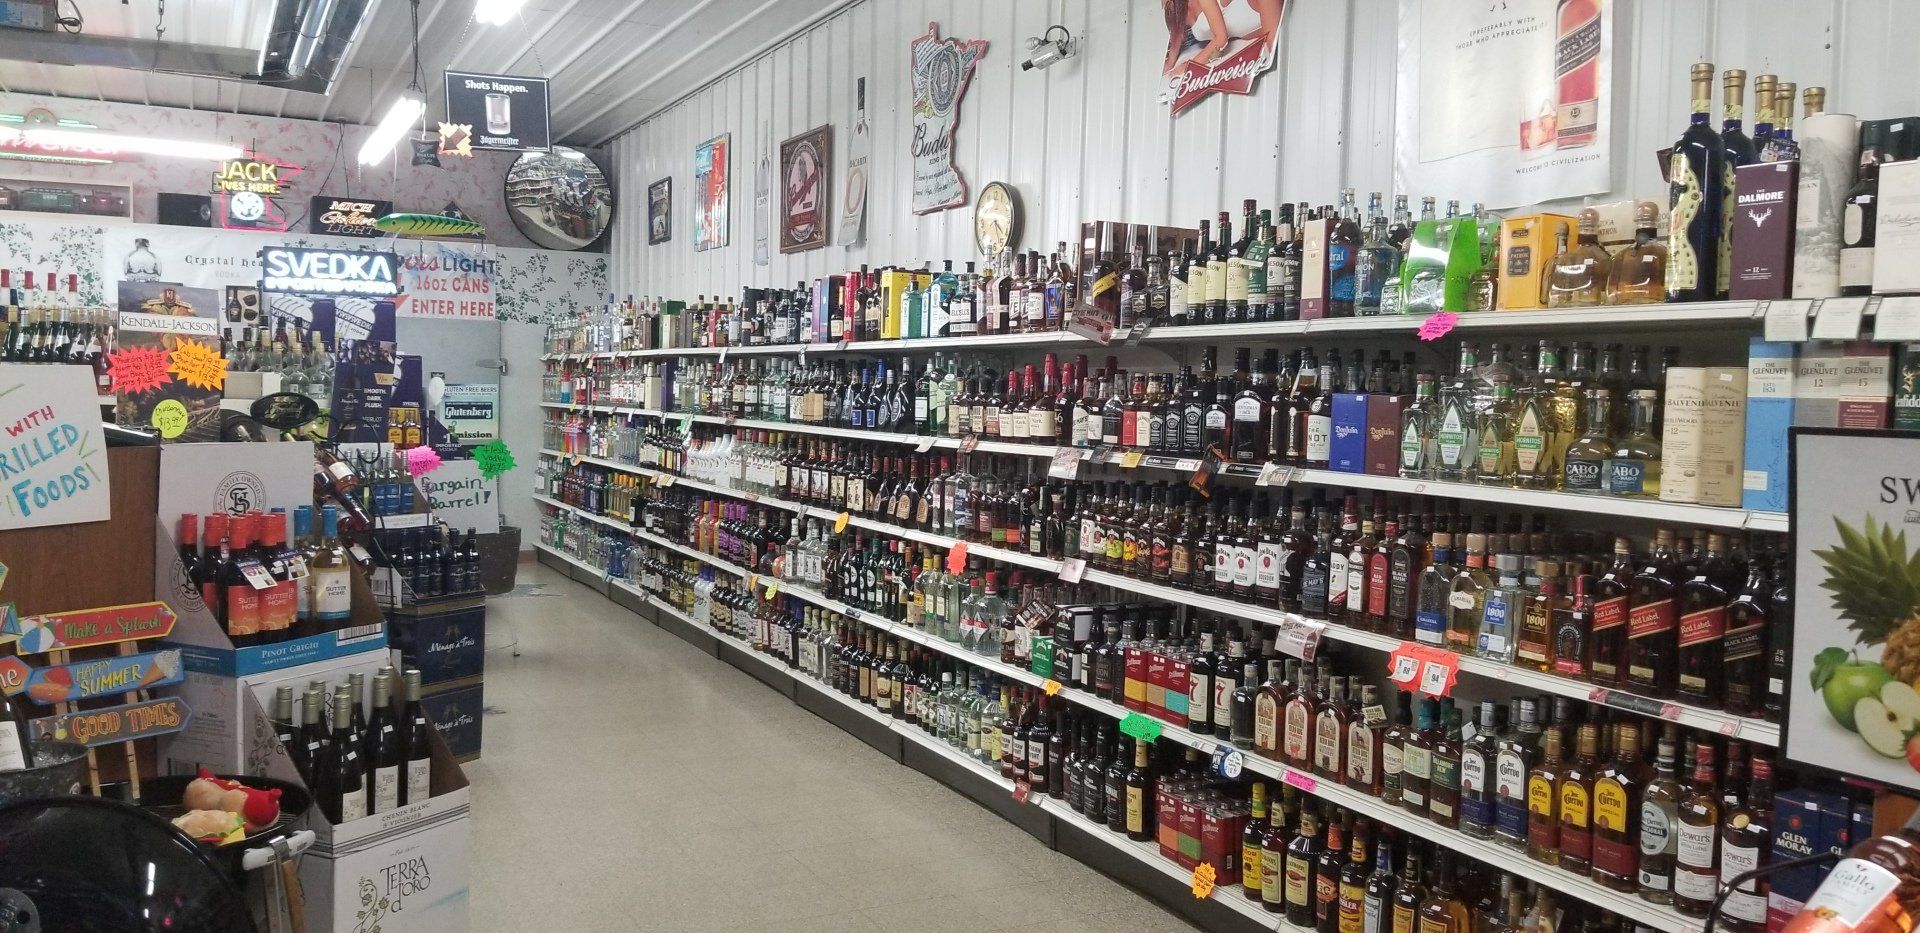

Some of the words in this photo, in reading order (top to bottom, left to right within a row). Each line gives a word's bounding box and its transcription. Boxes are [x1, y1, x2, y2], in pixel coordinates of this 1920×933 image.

[1517, 16, 1536, 25] WITH
[1492, 26, 1538, 40] APPRECIATE
[1169, 57, 1269, 99] Budweiser
[465, 80, 490, 90] Shots
[492, 82, 528, 93] Happen.
[1551, 153, 1602, 166] CIVILIZATION
[216, 161, 278, 183] JACK
[1738, 191, 1784, 204] DALMORE
[329, 201, 375, 213] MICH
[326, 224, 374, 235] LIGHT
[185, 254, 234, 267] Crystal
[267, 250, 392, 281] SVEDKA
[443, 258, 495, 275] LIGHT
[452, 278, 489, 293] CANS
[412, 300, 455, 315] ENTER
[460, 302, 494, 317] HERE
[120, 315, 216, 332] KENDALL-JACKSON
[1752, 367, 1788, 375] GLENLIVET
[1801, 367, 1838, 375] GLENLIVET
[1845, 366, 1884, 375] GLENLIVET
[1813, 378, 1823, 387] 12
[1858, 378, 1868, 387] 15
[446, 407, 492, 419] Glutenberg
[5, 406, 54, 437] WITH
[456, 431, 492, 439] mission
[1439, 434, 1463, 442] HORNITOS
[1516, 437, 1542, 445] HORNITOS
[0, 424, 79, 480] RILLED
[1566, 465, 1599, 475] CABO
[1486, 608, 1505, 618] 1800
[1526, 614, 1546, 626] 1800
[1594, 611, 1605, 619] Red
[1605, 607, 1620, 617] Label
[1630, 617, 1641, 626] Red
[1641, 613, 1659, 624] Label
[64, 623, 97, 640] Make
[105, 625, 112, 633] a
[116, 616, 162, 638] Splash
[1681, 624, 1692, 634] Red
[1692, 620, 1711, 631] Label
[262, 649, 286, 659] PINOT
[289, 641, 319, 653] GRIGIO
[76, 658, 112, 681] HAPPY
[81, 665, 143, 697] SUMMER
[1431, 673, 1439, 683] 94
[1215, 683, 1225, 706] 7
[72, 712, 120, 744] GOOD
[126, 702, 180, 733] TIMES
[1463, 761, 1481, 774] Cuervo
[1500, 764, 1520, 778] Cuervo
[1531, 787, 1548, 799] Cuervo
[1598, 792, 1621, 808] Cuervo
[1563, 793, 1584, 808] Cuervo
[382, 808, 408, 822] CHENIN
[1679, 827, 1710, 843] Dewar's
[1782, 832, 1807, 844] GLEN
[1776, 839, 1813, 856] MORAY
[1724, 848, 1753, 866] Dewar's
[379, 856, 429, 896] TERRA
[1835, 870, 1875, 890] Gallo
